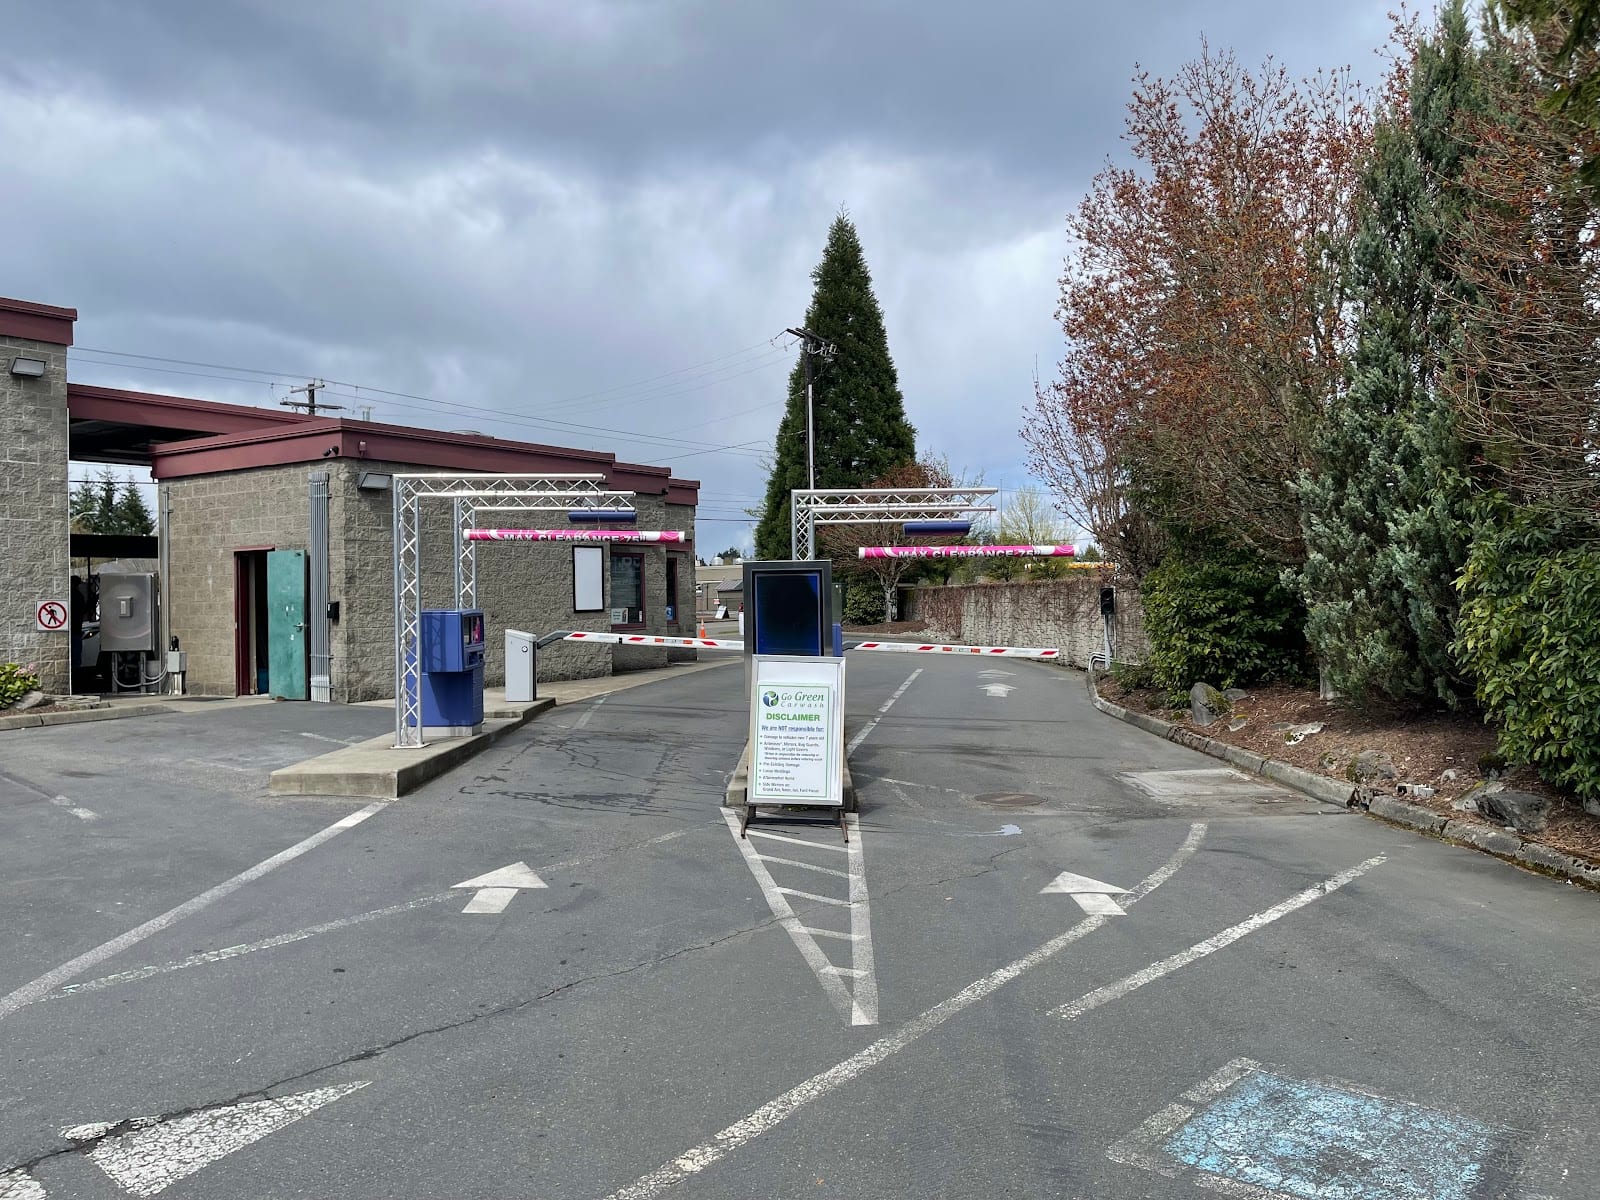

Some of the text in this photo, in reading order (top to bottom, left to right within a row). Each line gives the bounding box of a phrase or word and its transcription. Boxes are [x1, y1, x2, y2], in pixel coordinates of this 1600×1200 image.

[503, 534, 534, 542] MAX
[538, 534, 621, 543] CLEARANCE
[898, 549, 928, 558] MAX
[932, 549, 1012, 558] CLEARANCE
[781, 691, 824, 702] Go Green
[780, 701, 824, 709] Carwash
[766, 713, 820, 722] DISCLAIMER
[788, 725, 815, 733] responsible
